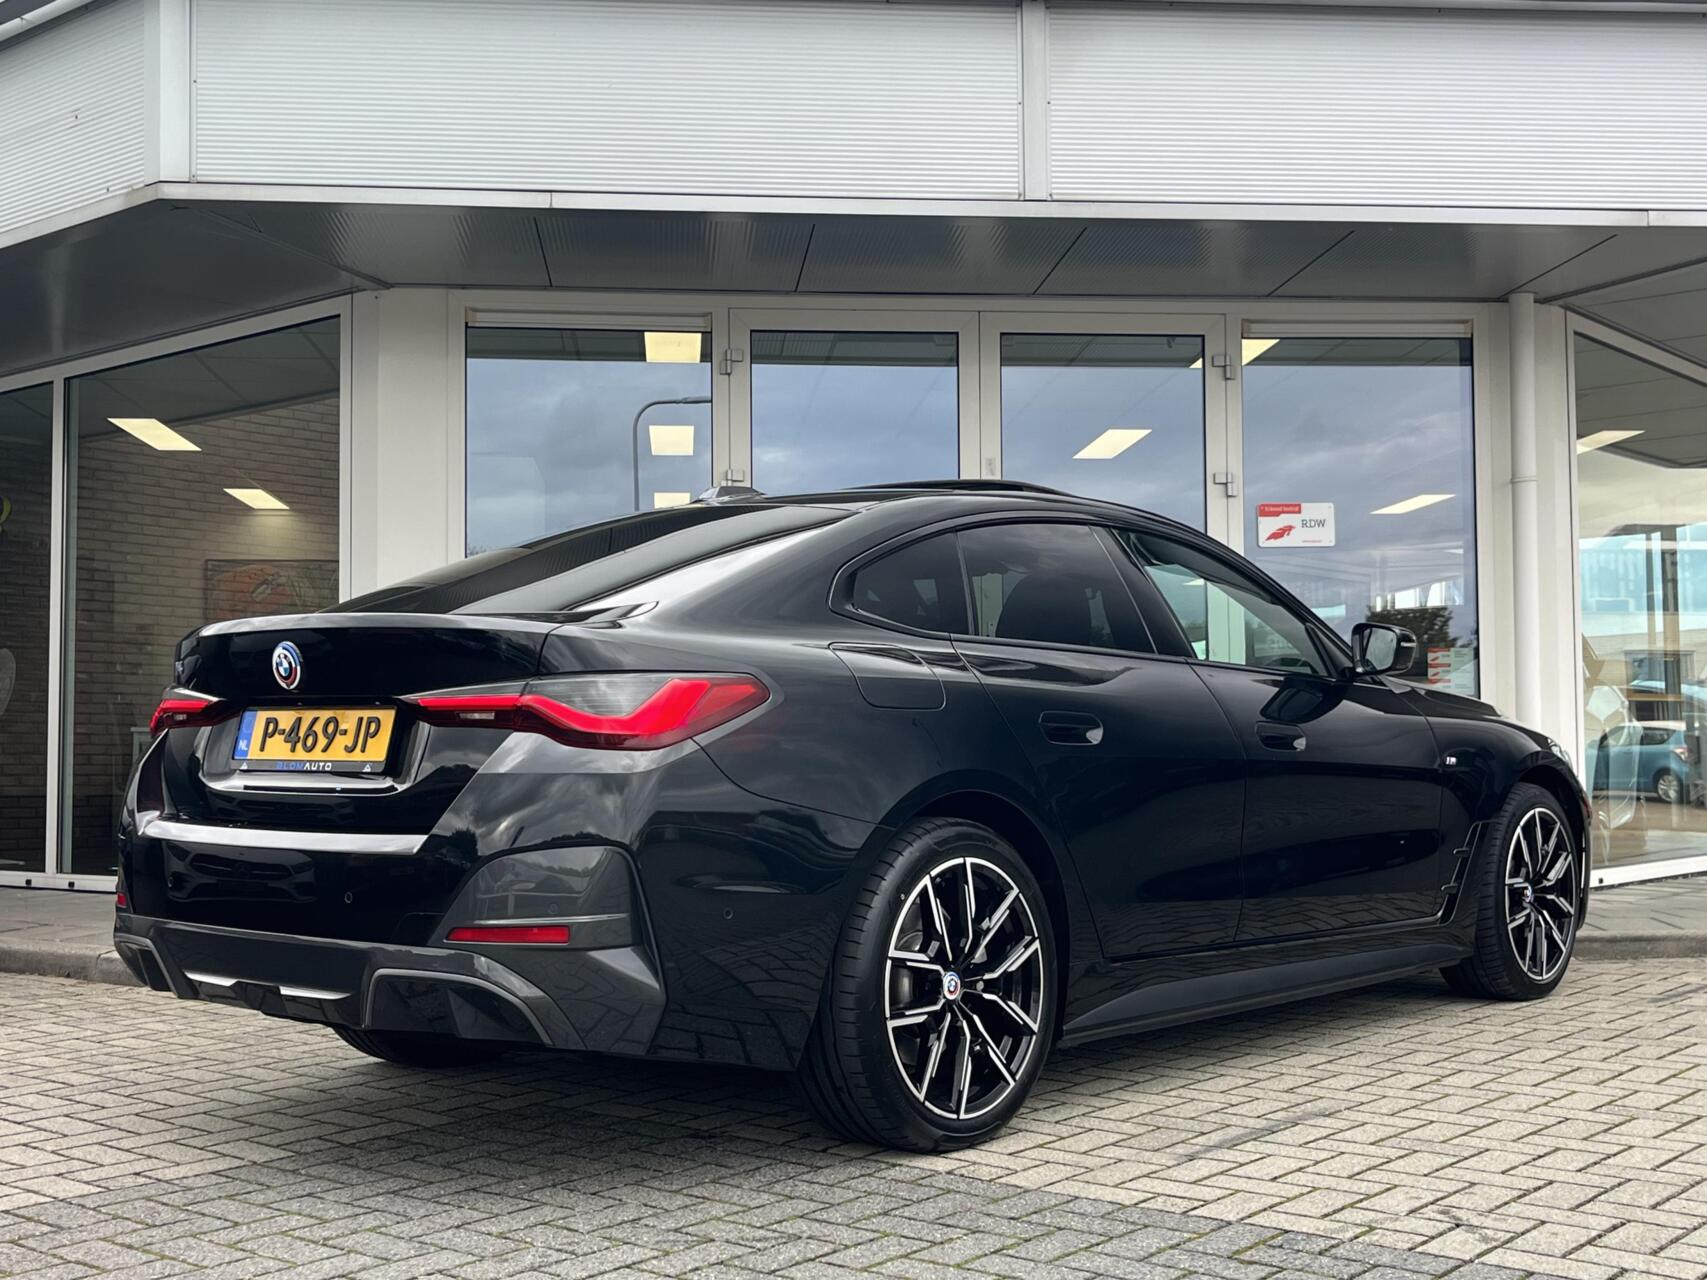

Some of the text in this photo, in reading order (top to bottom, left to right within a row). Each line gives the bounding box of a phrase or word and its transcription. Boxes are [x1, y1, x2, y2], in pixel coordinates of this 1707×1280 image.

[1301, 519, 1326, 528] RDW
[259, 716, 381, 753] P-469-JP
[238, 739, 248, 750] NL
